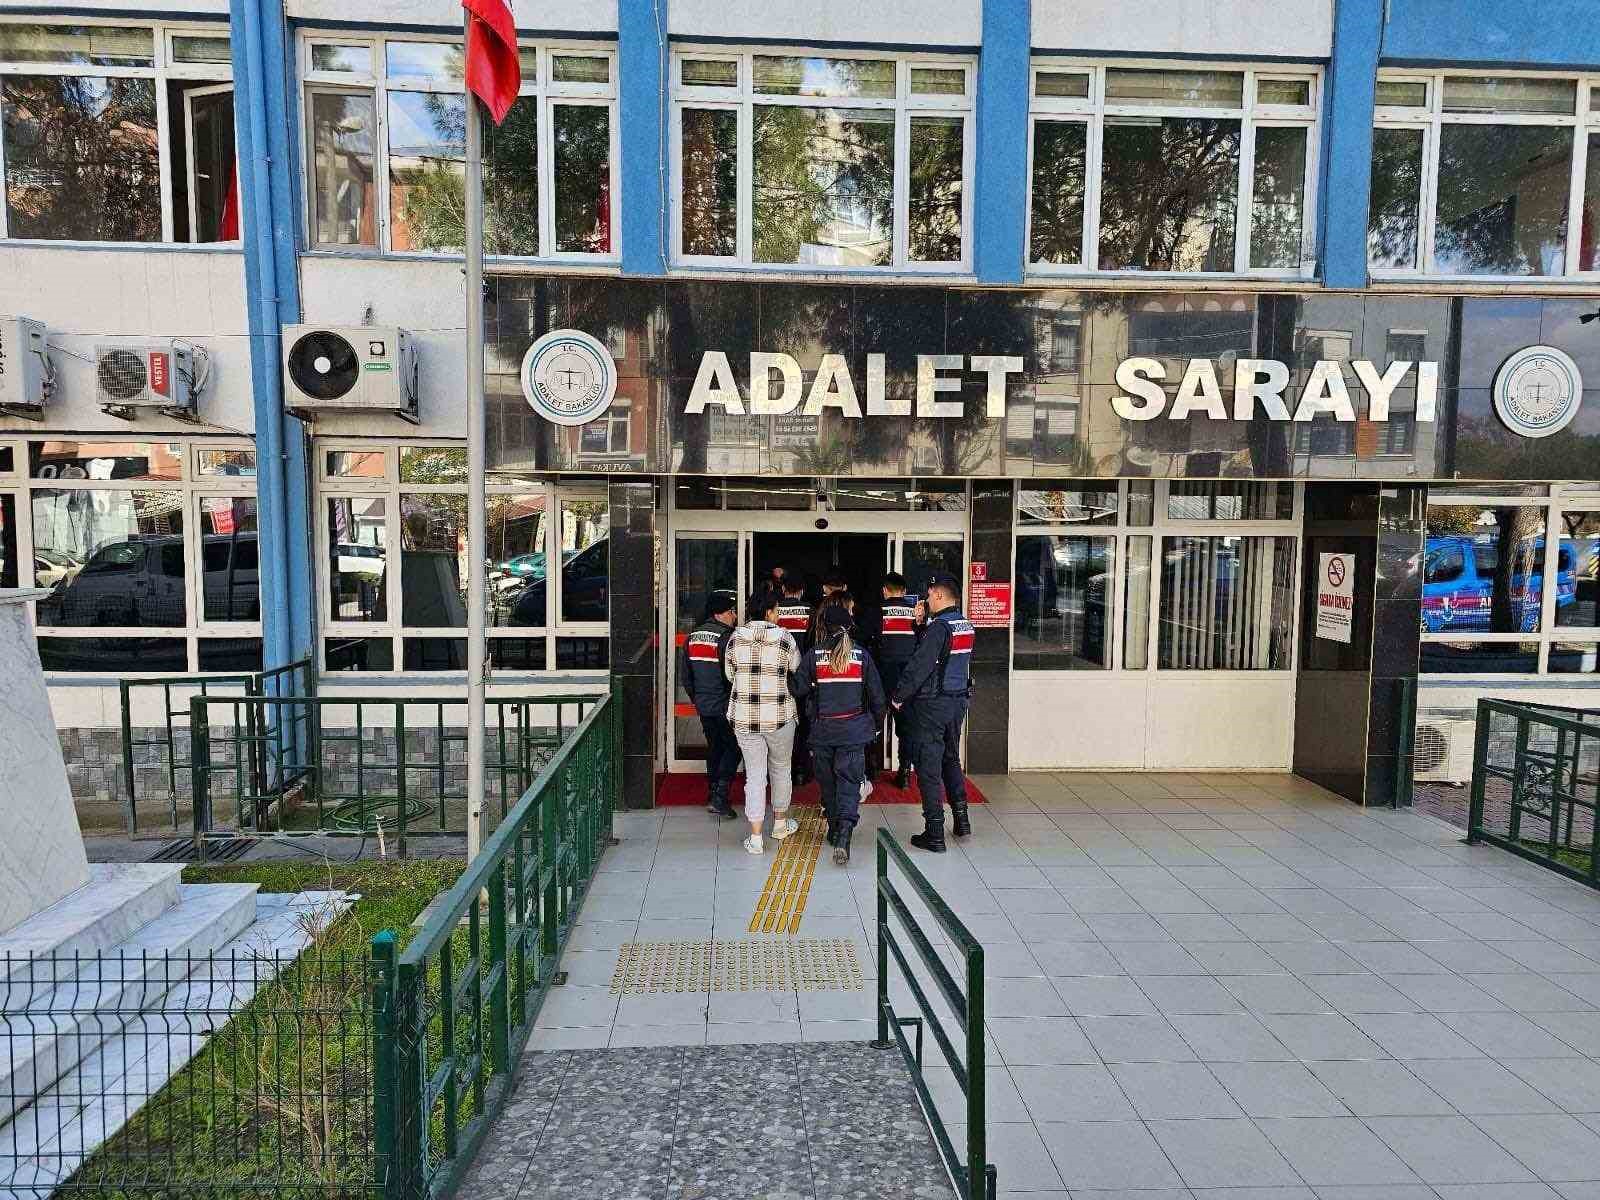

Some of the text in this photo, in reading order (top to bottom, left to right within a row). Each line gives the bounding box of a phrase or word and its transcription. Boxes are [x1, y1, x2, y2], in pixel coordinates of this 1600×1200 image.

[537, 382, 562, 408] ADALET
[684, 351, 1439, 422] ADALET SARAYI
[1510, 397, 1529, 418] ADALET
